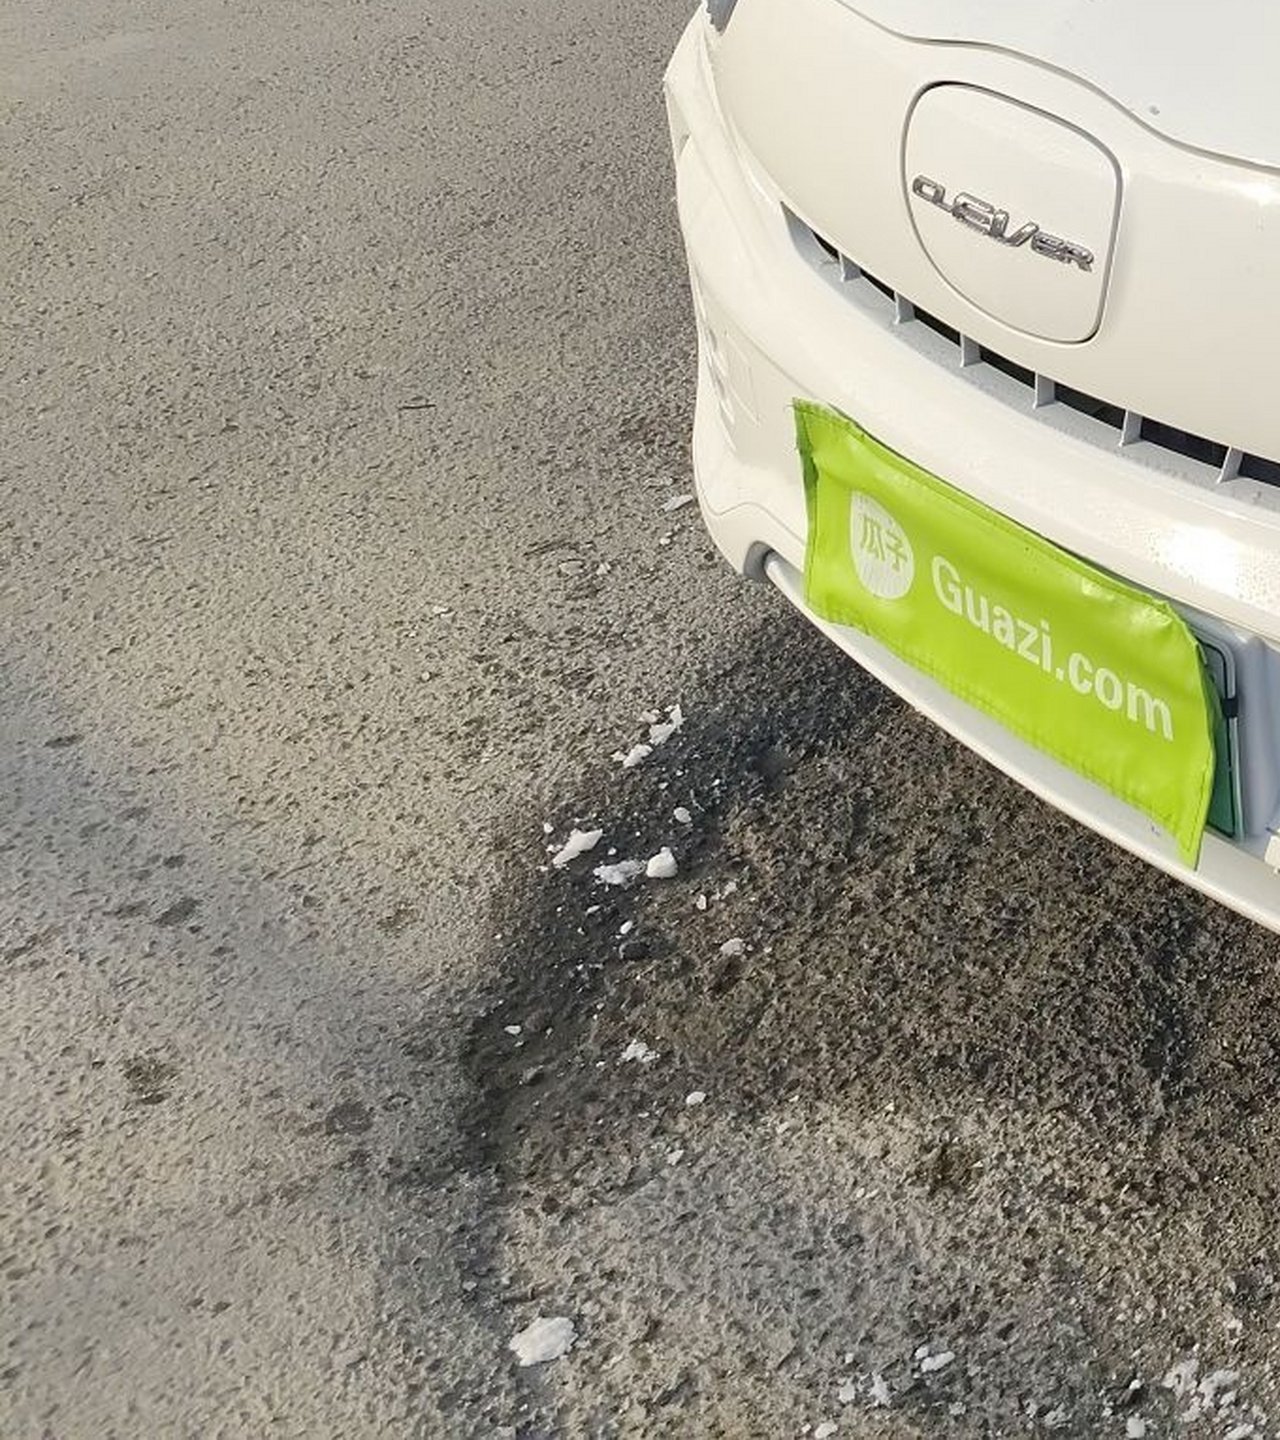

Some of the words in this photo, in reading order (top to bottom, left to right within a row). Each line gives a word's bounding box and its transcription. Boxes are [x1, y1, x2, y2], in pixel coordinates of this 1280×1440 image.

[912, 175, 1095, 273] CLEVER
[860, 515, 909, 574] 瓜子
[931, 555, 1175, 742] Guazi.com
